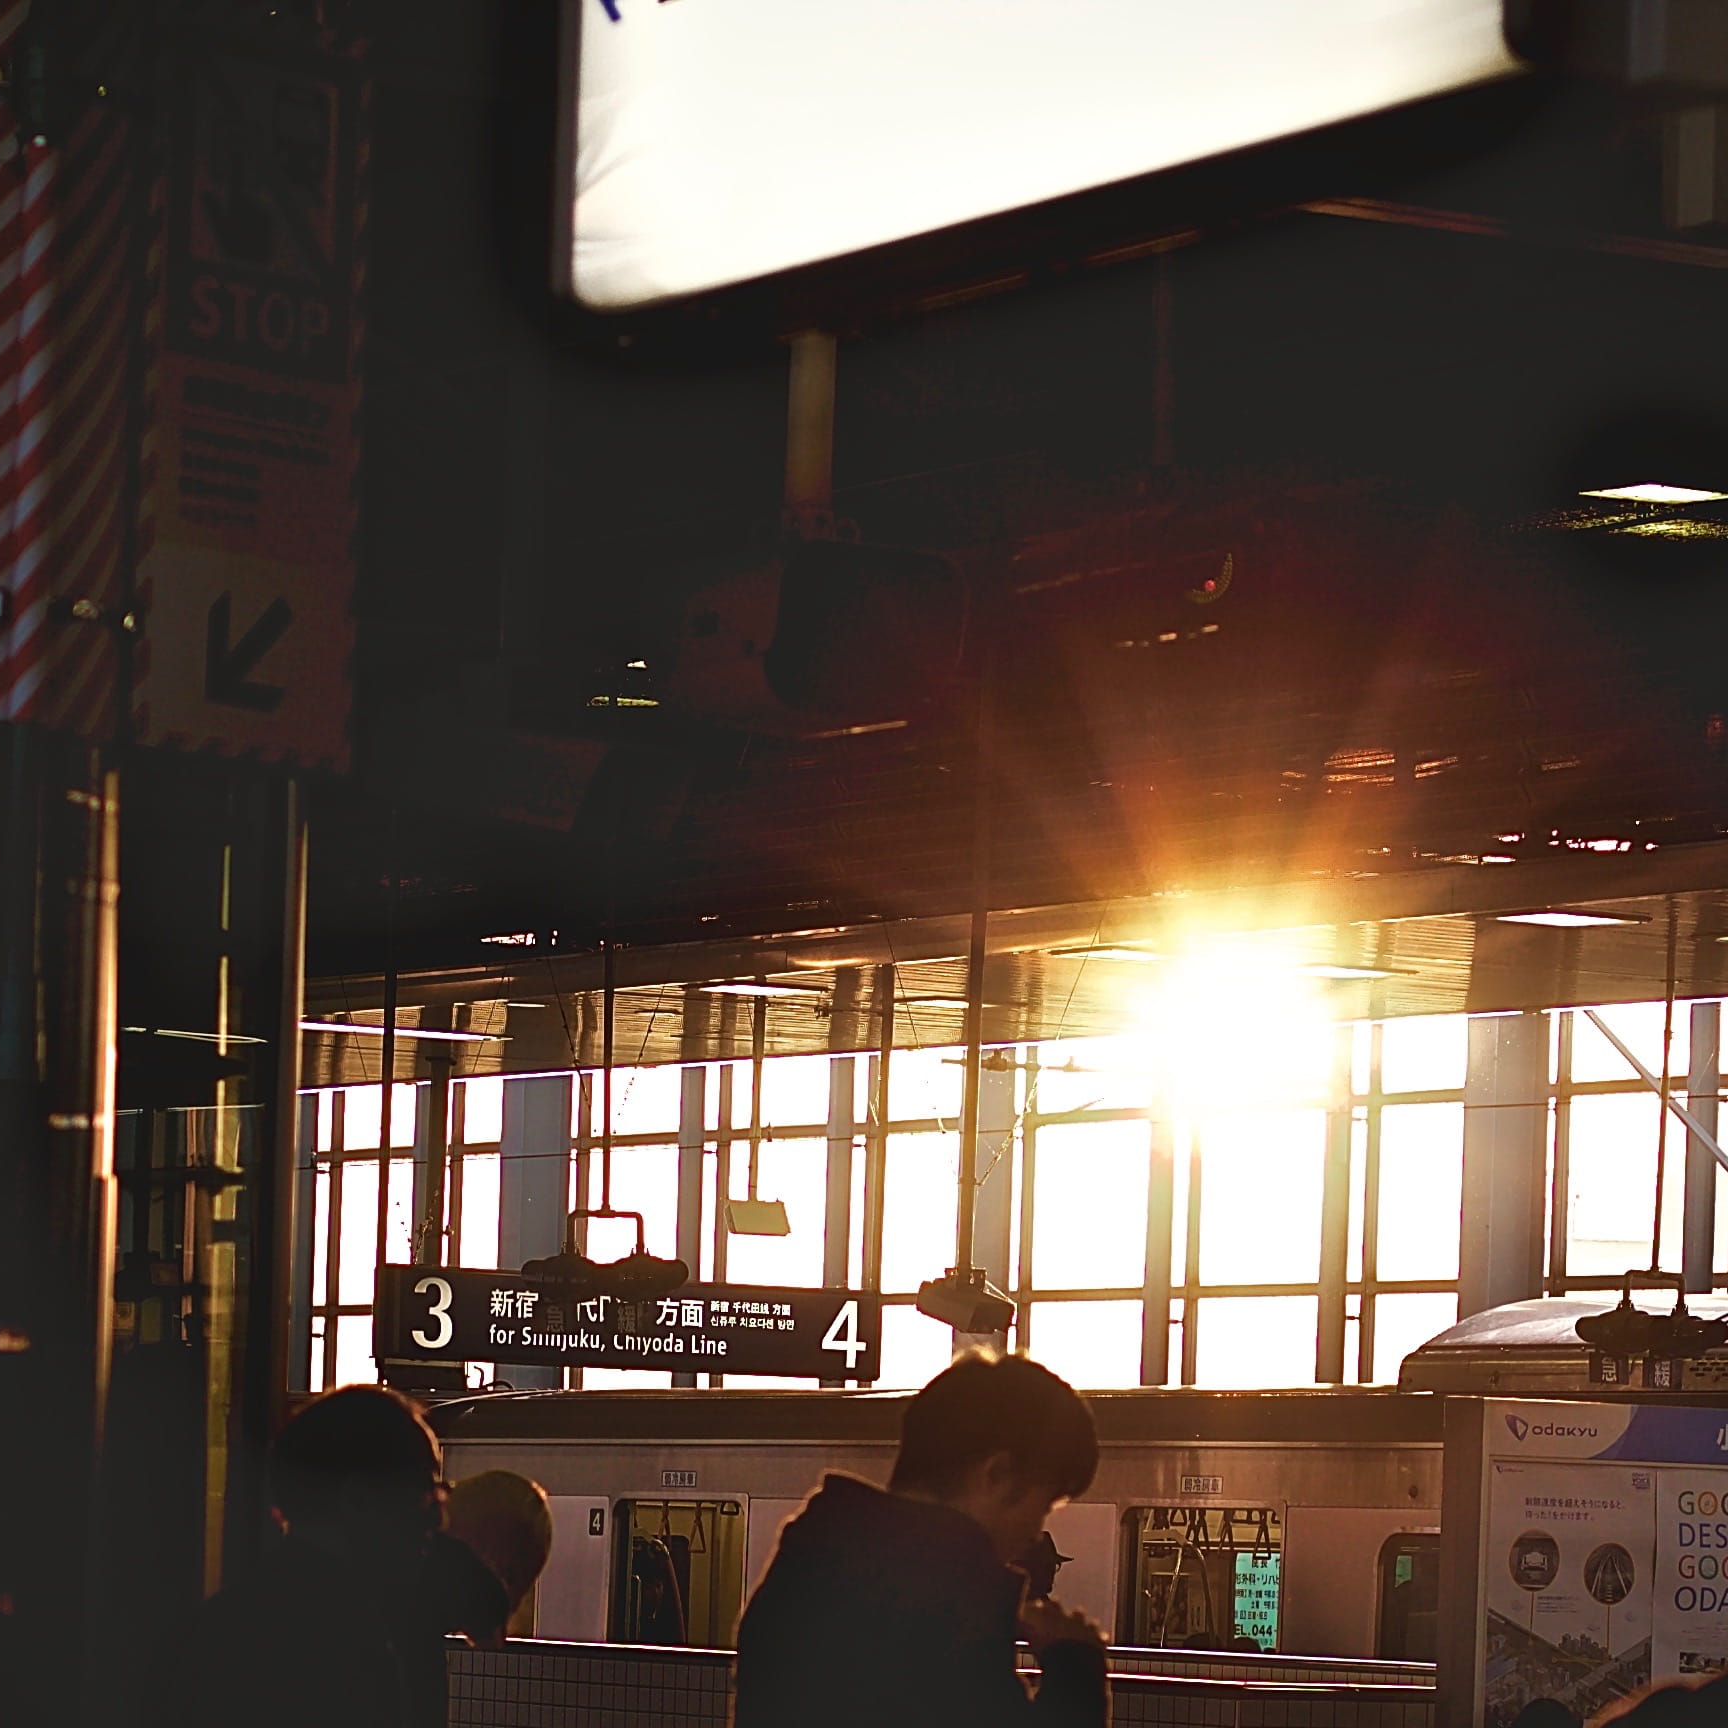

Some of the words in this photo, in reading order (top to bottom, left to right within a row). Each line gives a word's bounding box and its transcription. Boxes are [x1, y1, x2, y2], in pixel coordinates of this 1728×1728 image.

[189, 275, 329, 356] STOP
[412, 1276, 453, 1349] 3
[489, 1289, 539, 1319] 新宿
[656, 1298, 704, 1328] 方面
[821, 1300, 867, 1369] 4
[489, 1324, 515, 1345] for
[691, 1334, 727, 1355] Line
[592, 1512, 601, 1531] 4
